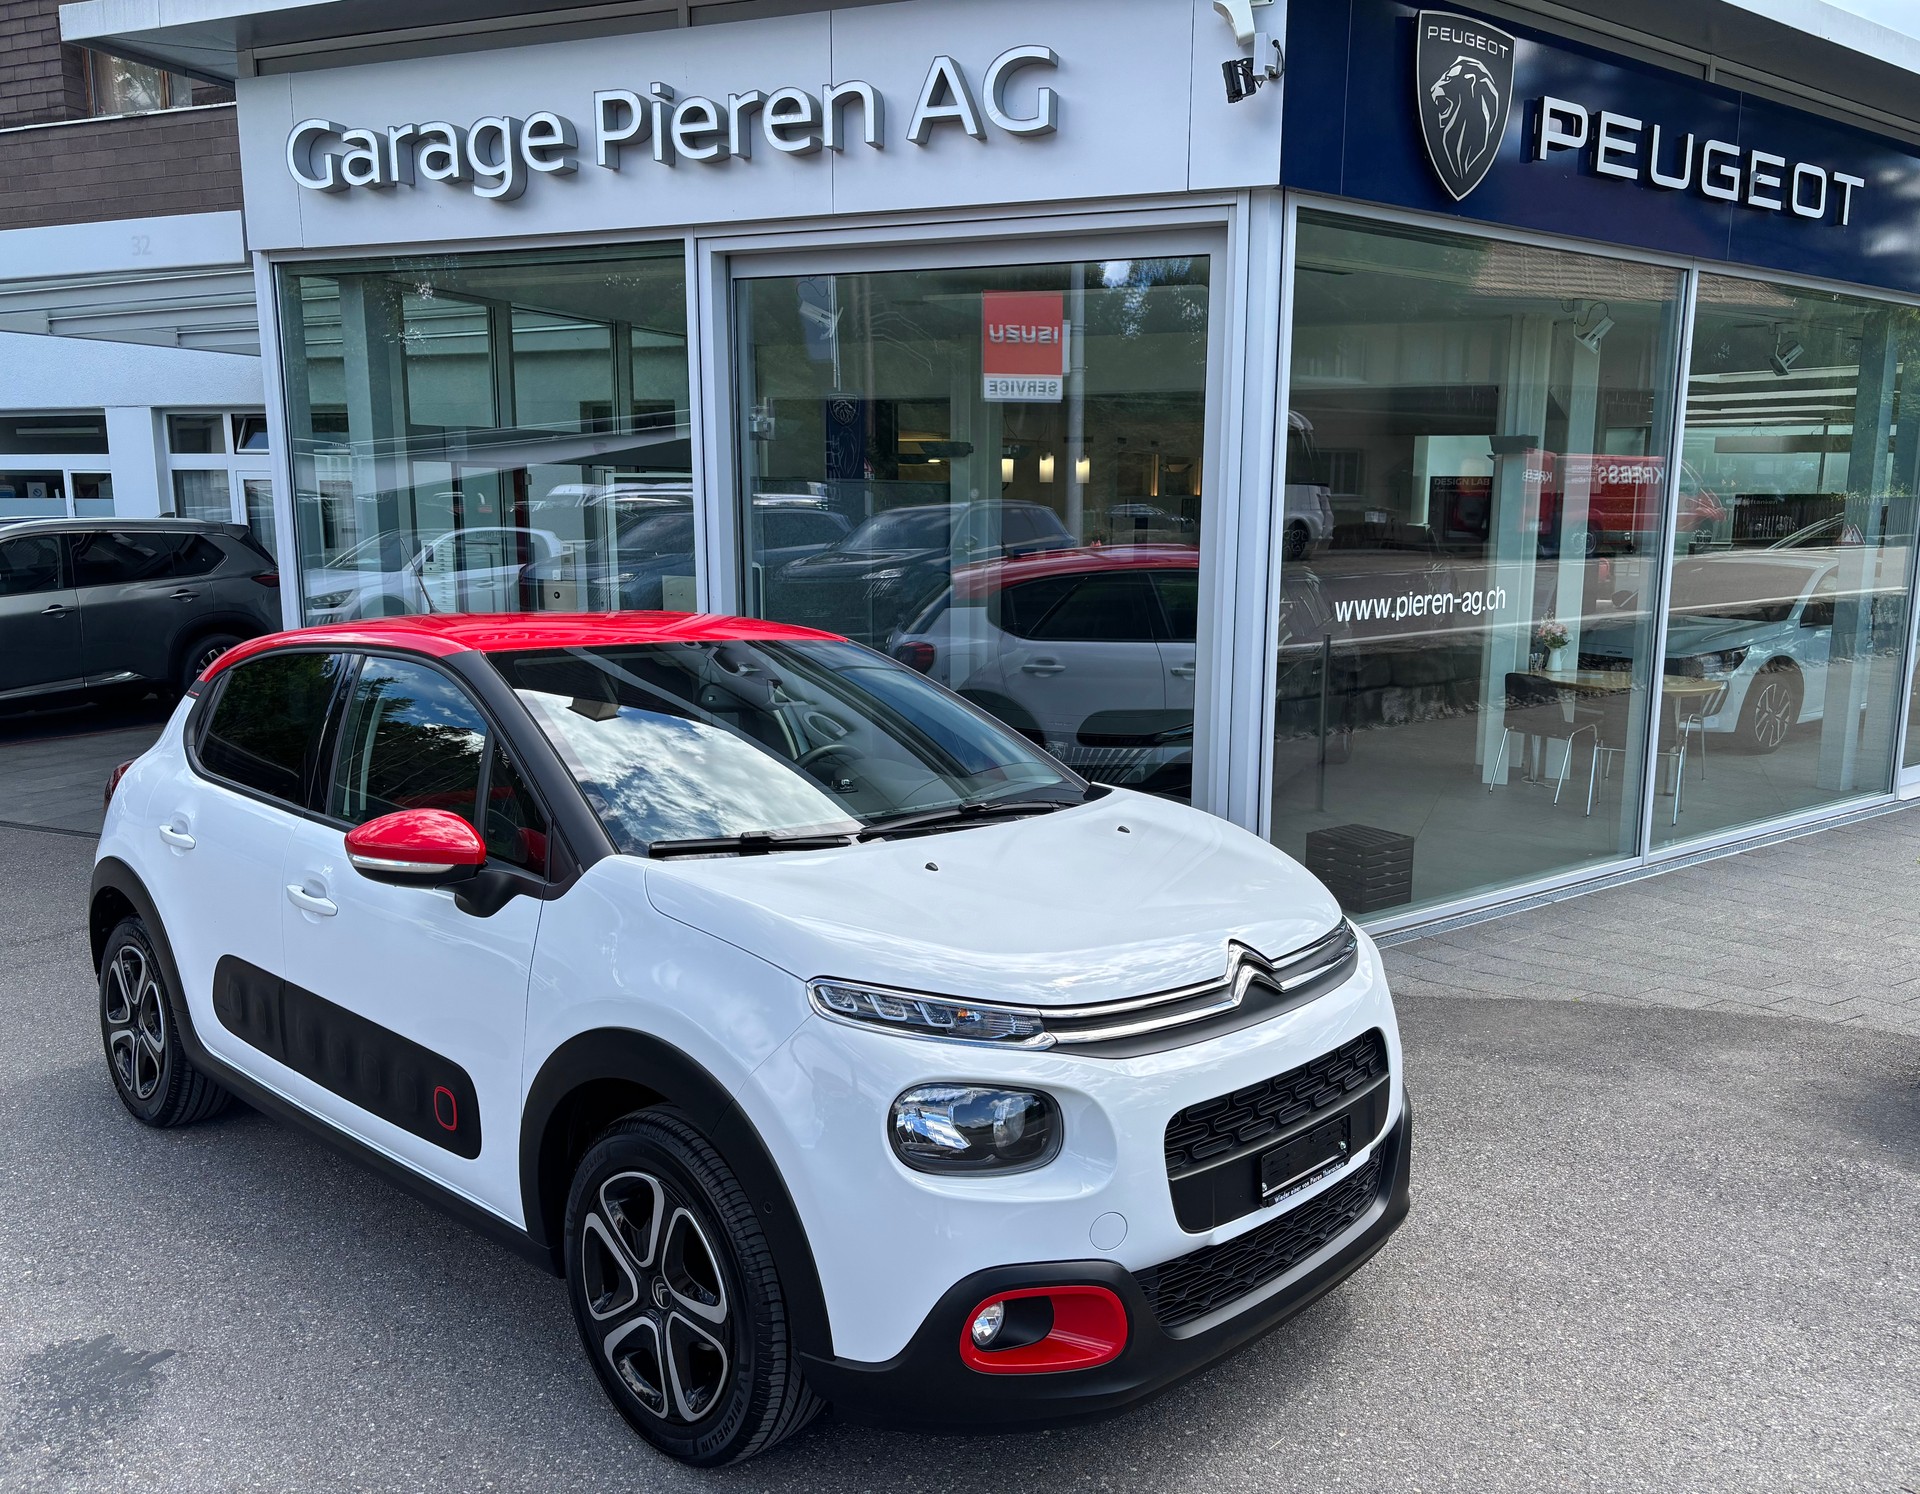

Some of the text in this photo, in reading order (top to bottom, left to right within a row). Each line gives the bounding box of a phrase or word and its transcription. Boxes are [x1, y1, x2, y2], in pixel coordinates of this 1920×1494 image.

[1427, 25, 1509, 59] PEUGEOT
[286, 45, 1059, 200] Garage Pieren AG
[1535, 95, 1865, 226] PEUGEOT
[131, 234, 152, 257] 32
[1434, 478, 1490, 486] DESIGN LAB
[1335, 586, 1506, 623] www.pieren-ag.ch
[700, 1395, 744, 1454] MICHELIN
